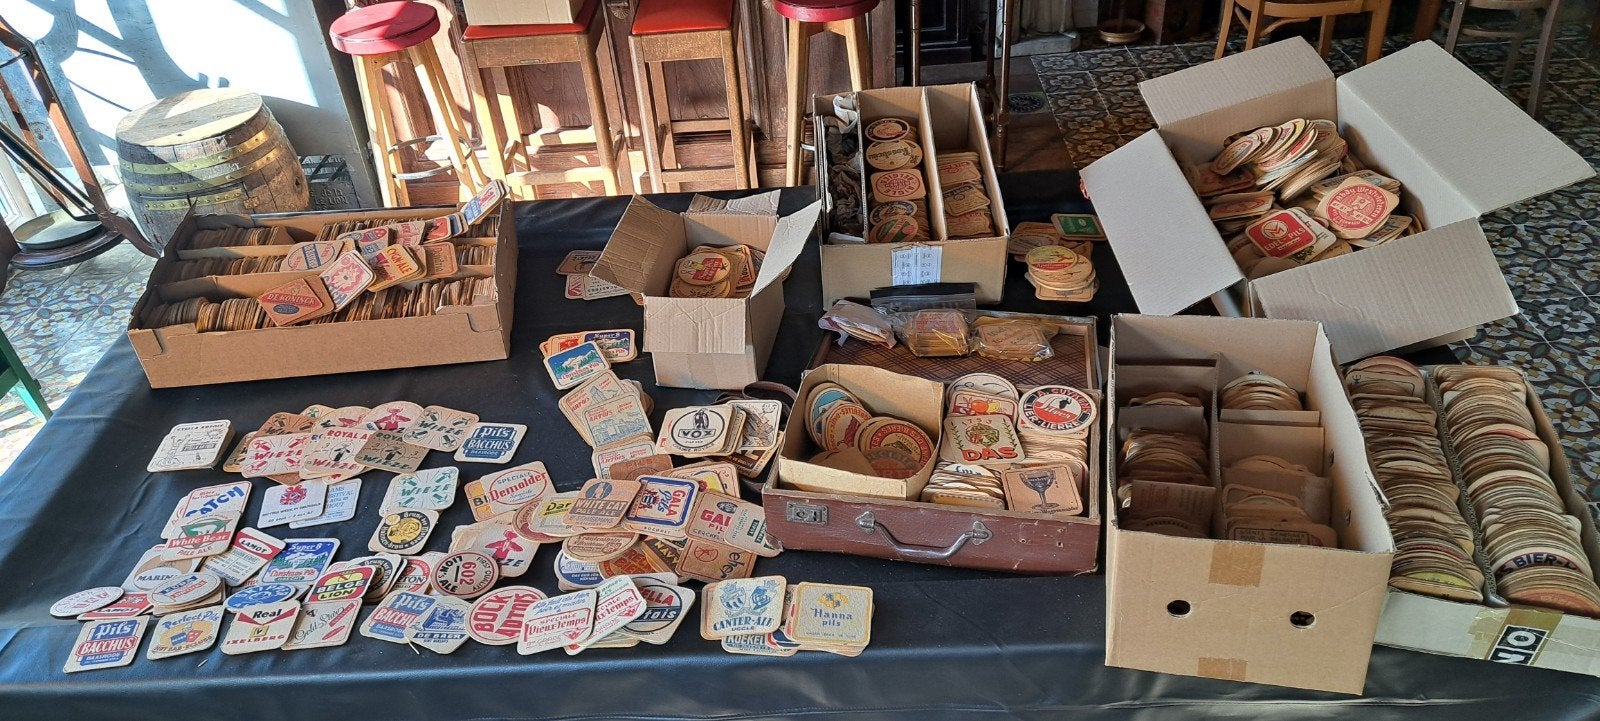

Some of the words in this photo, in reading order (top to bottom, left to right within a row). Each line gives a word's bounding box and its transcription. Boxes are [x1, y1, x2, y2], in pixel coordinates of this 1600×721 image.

[327, 430, 357, 439] ROYAL
[420, 421, 464, 436] WIEZE
[480, 427, 511, 438] Pils
[682, 430, 712, 438] VOX
[376, 432, 404, 442] ROYA
[467, 440, 511, 450] BACCHUS
[254, 450, 303, 461] WIEZE
[962, 447, 1019, 461] DAS
[312, 459, 359, 471] WIEZE
[363, 455, 410, 469] WIEZE
[497, 472, 531, 484] SPECIALE
[401, 483, 451, 497] WIEZE
[489, 472, 546, 502] Demolder
[575, 499, 607, 510] WHITE
[606, 501, 627, 511] CAT
[666, 489, 686, 517] GALA
[171, 537, 201, 547] White
[203, 534, 228, 544] Bear
[240, 539, 268, 553] LAMOT
[460, 561, 477, 587] 602
[316, 579, 365, 594] BELGE
[439, 580, 459, 593] ALE
[320, 589, 354, 599] LION
[641, 588, 675, 607] ELLA
[253, 609, 282, 619] Real
[373, 608, 418, 628] BACCHU
[474, 593, 515, 632] BOCK
[643, 608, 677, 620] tois
[810, 607, 854, 620] Hanna
[162, 612, 202, 630] Perfect
[822, 619, 841, 628] pils
[95, 620, 133, 639] Pils
[81, 637, 136, 655] BACCHUS
